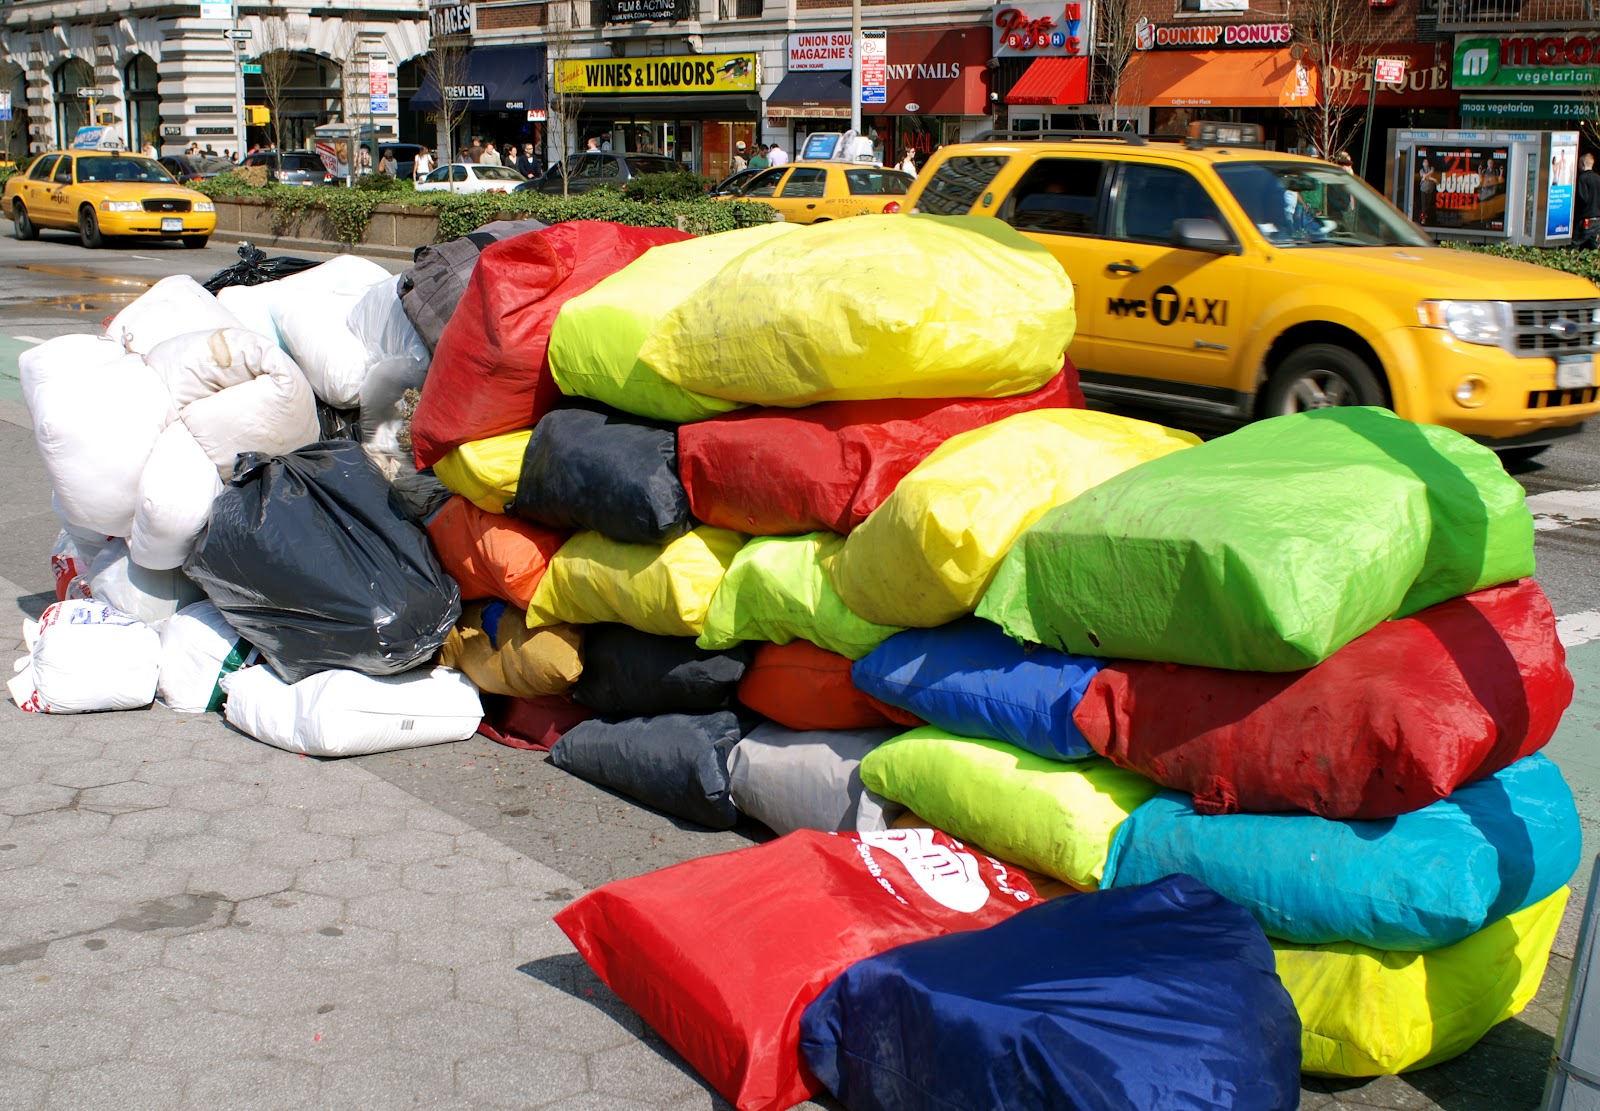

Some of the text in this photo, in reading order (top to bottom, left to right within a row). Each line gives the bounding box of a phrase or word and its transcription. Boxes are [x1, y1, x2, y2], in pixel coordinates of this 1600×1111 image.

[618, 0, 675, 12] FILM & ACTING
[1065, 3, 1081, 54] NYC
[1157, 24, 1291, 45] DUNKIN' DONUTS
[798, 35, 829, 47] UNION
[831, 34, 852, 46] SQU
[790, 48, 846, 60] MAGAZINE
[586, 61, 715, 87] WINES & LIQUORS
[886, 64, 915, 80] NNY
[917, 62, 960, 79] NAILS
[1516, 70, 1592, 83] vegetarian
[444, 86, 465, 97] TREVI
[1462, 103, 1485, 111] maoz
[1487, 103, 1534, 114] vegetarian
[1436, 172, 1480, 194] JUMP
[1436, 192, 1479, 209] STREET
[1106, 285, 1229, 326] NYC TAXI
[857, 843, 882, 877] South
